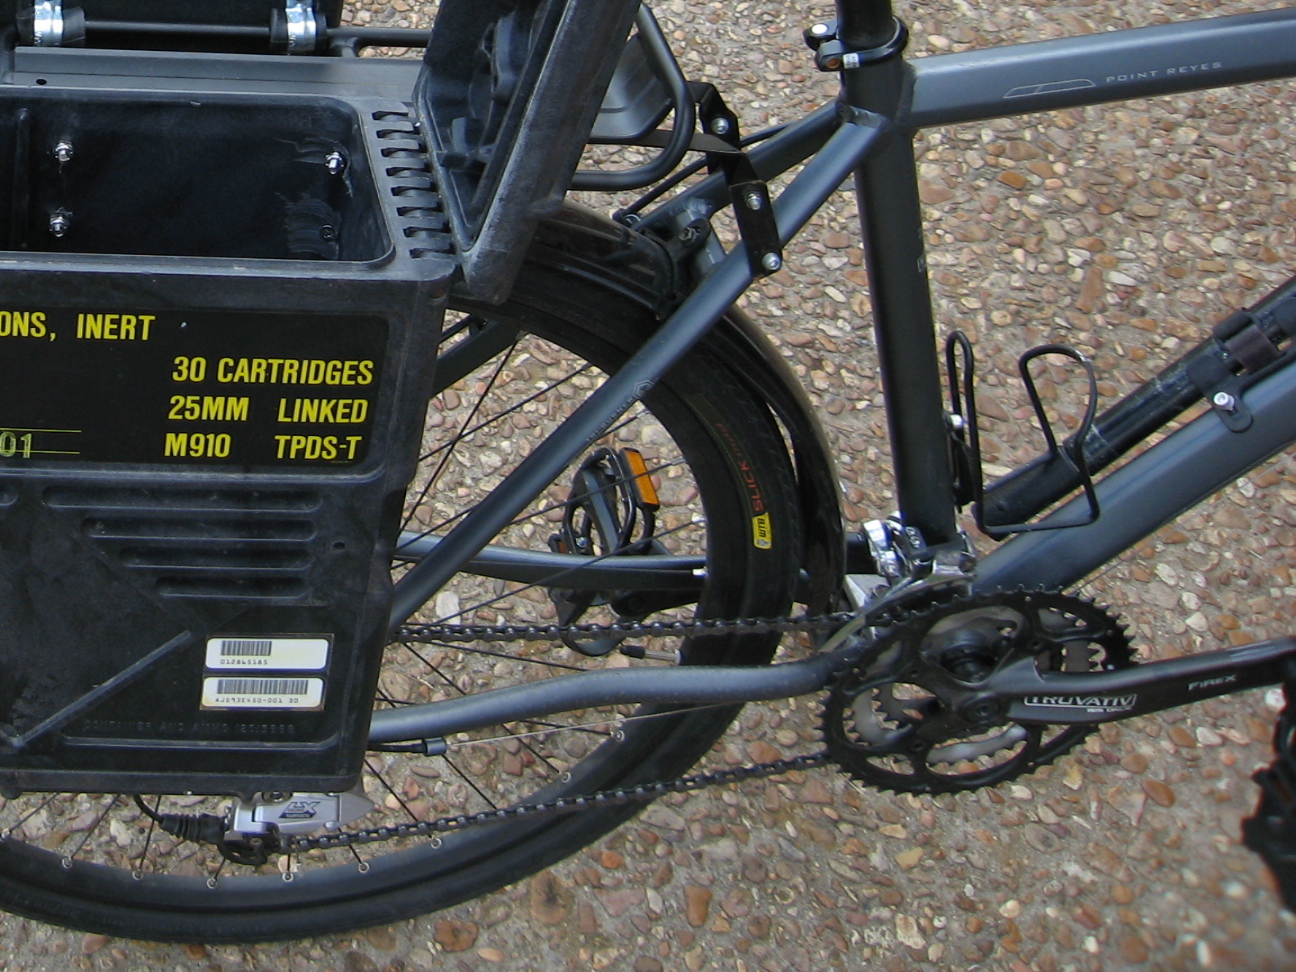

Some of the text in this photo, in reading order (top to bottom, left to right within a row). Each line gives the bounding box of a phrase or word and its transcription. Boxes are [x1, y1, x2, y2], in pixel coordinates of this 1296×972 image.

[1106, 61, 1222, 83] POINT REYES
[76, 313, 156, 341] INERT
[172, 356, 374, 385] 30 CARTRIDGES
[168, 395, 369, 424] 25MM LINKED
[164, 432, 363, 460] M910 TPDS-T
